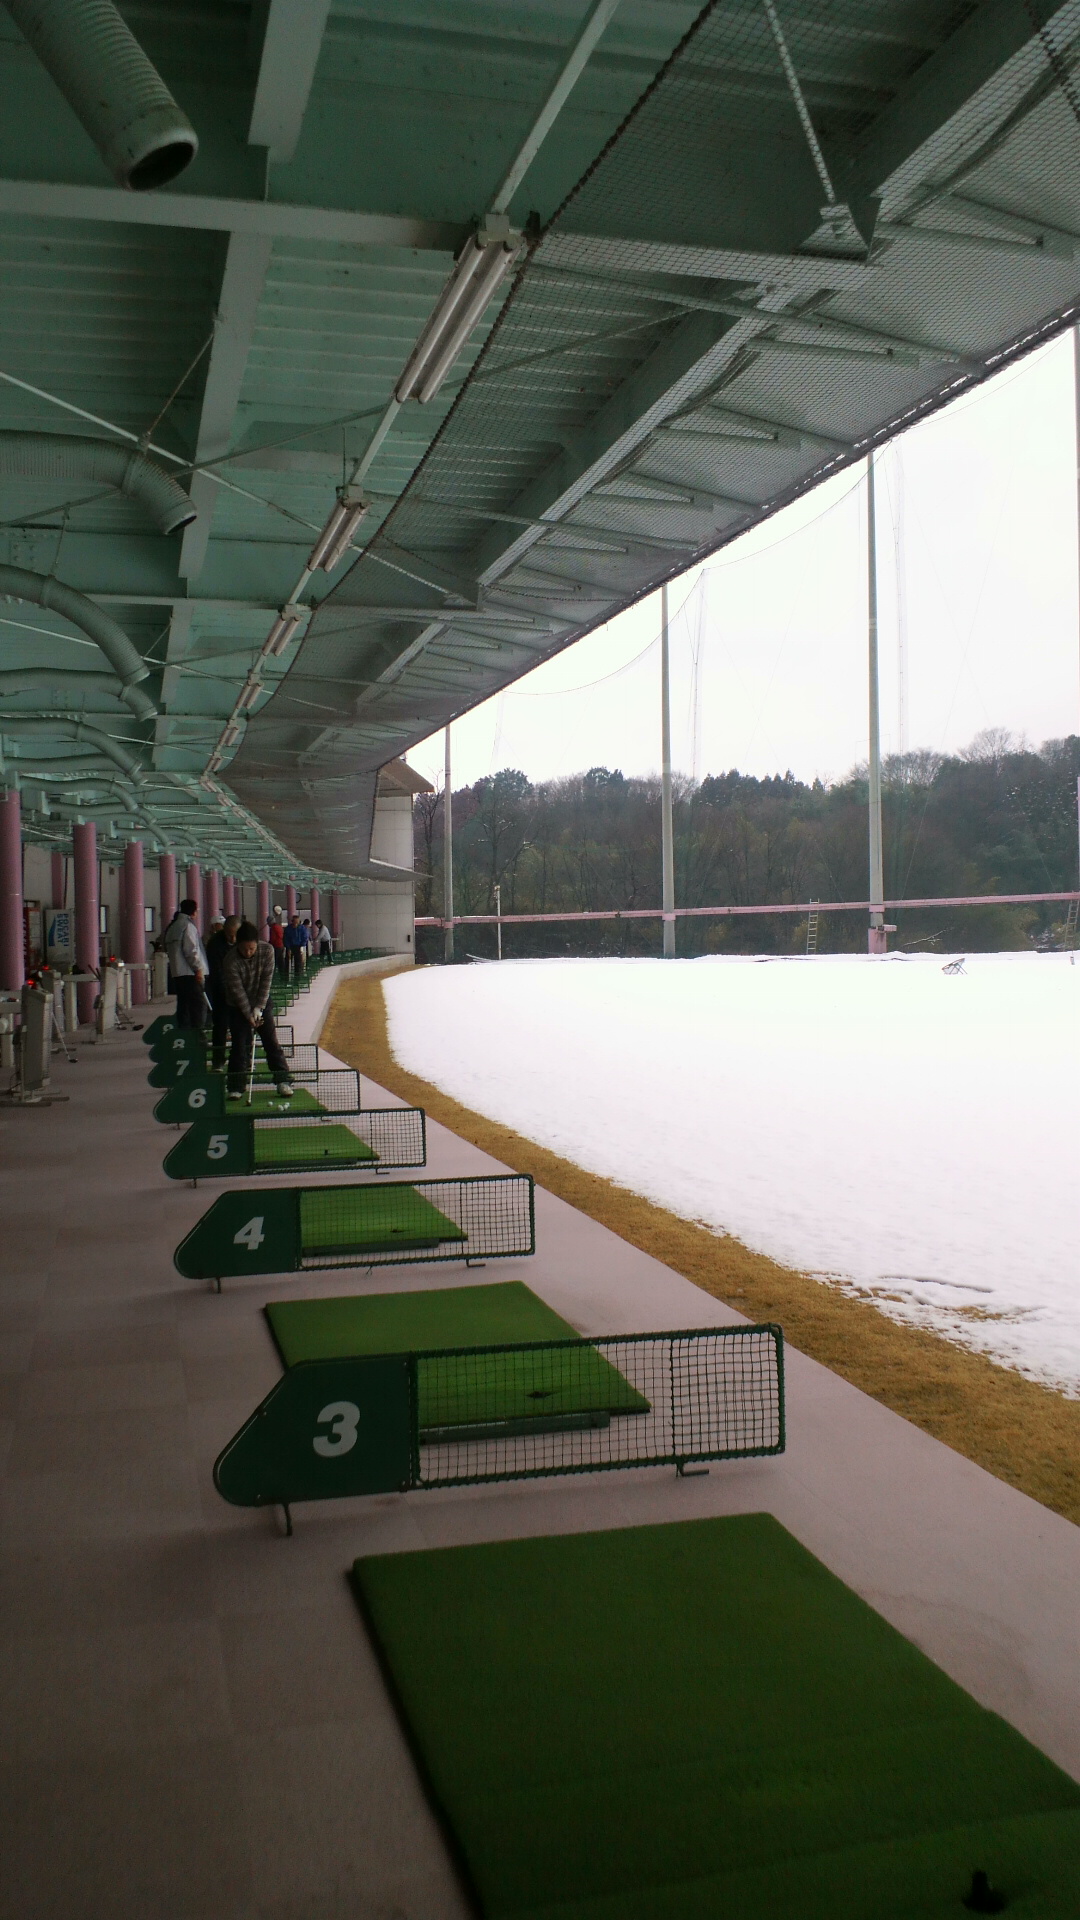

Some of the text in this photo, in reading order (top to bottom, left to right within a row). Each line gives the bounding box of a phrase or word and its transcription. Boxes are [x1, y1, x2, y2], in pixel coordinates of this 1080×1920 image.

[176, 1060, 190, 1076] 7
[188, 1088, 207, 1108] 6
[207, 1134, 229, 1159] 5
[233, 1216, 265, 1250] 4
[312, 1401, 360, 1457] 3
